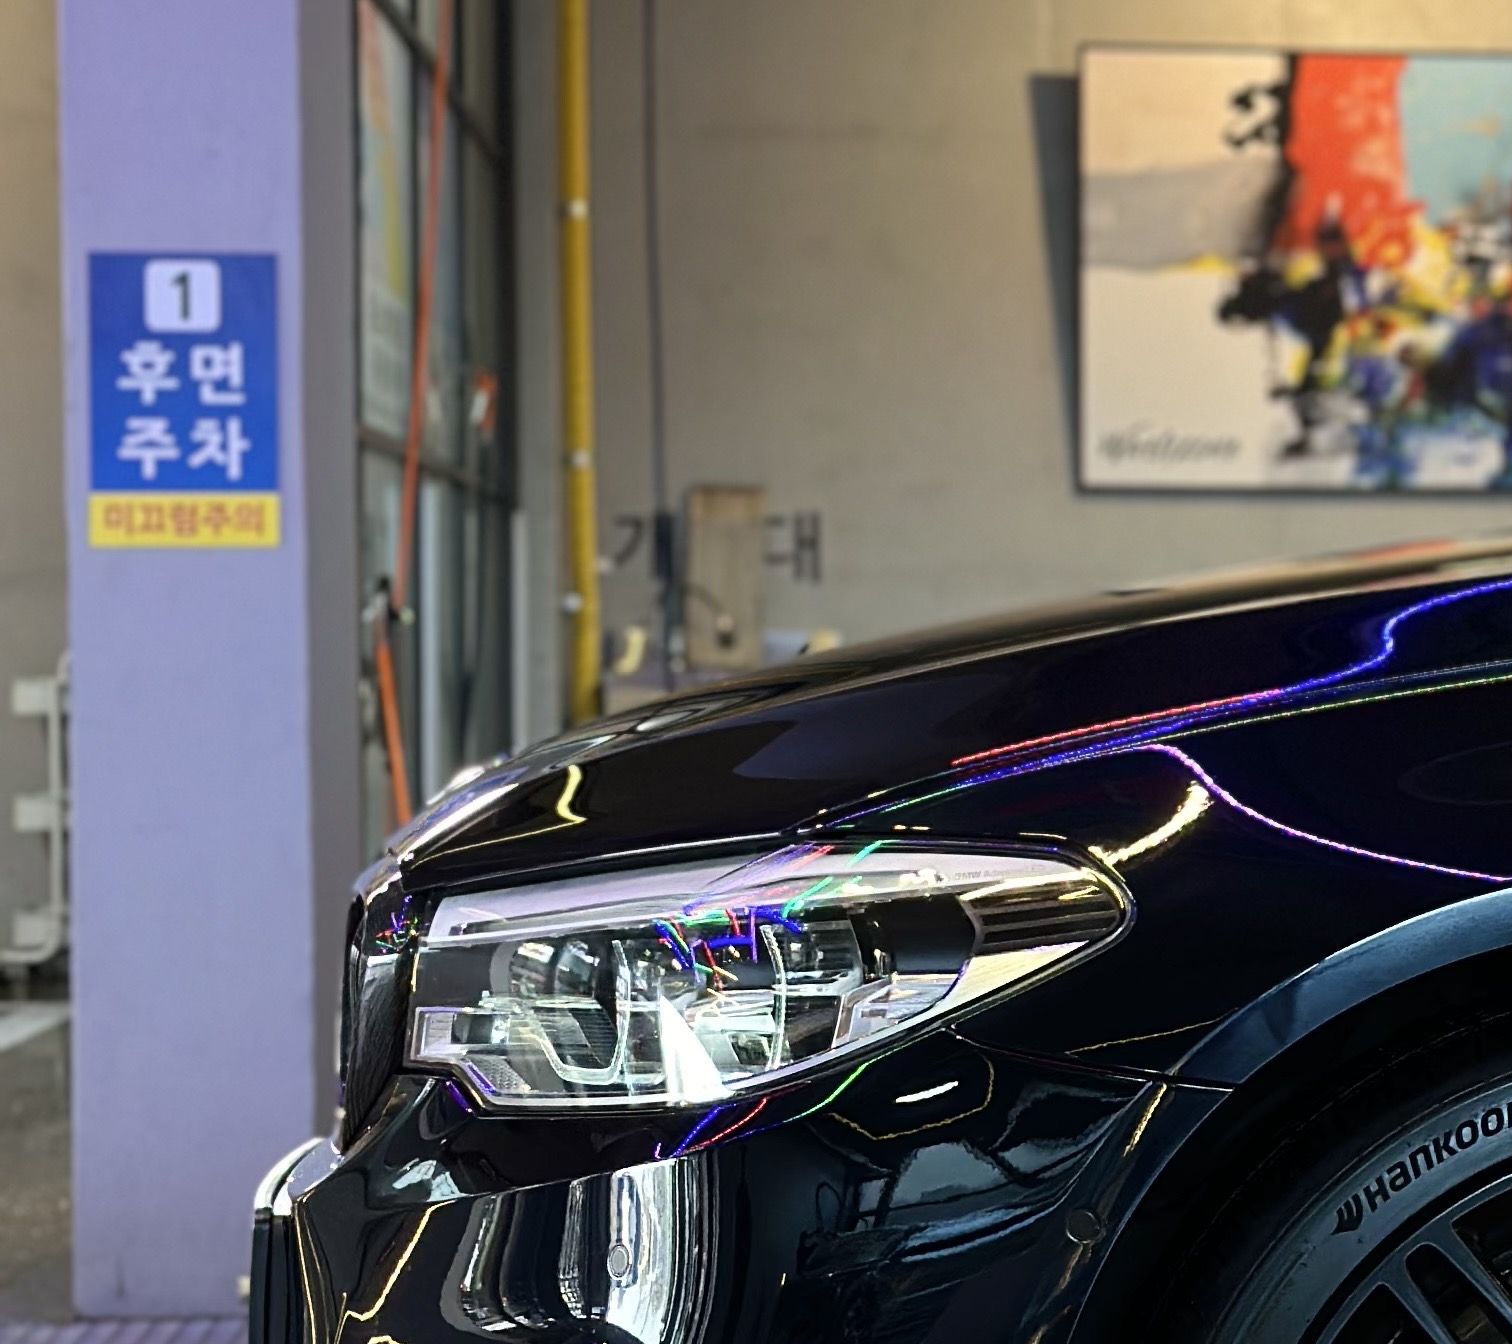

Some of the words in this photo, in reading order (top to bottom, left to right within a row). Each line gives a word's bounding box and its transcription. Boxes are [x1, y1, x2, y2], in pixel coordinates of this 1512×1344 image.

[169, 269, 191, 322] 1
[115, 339, 247, 406] 후면
[115, 415, 252, 481] 주차
